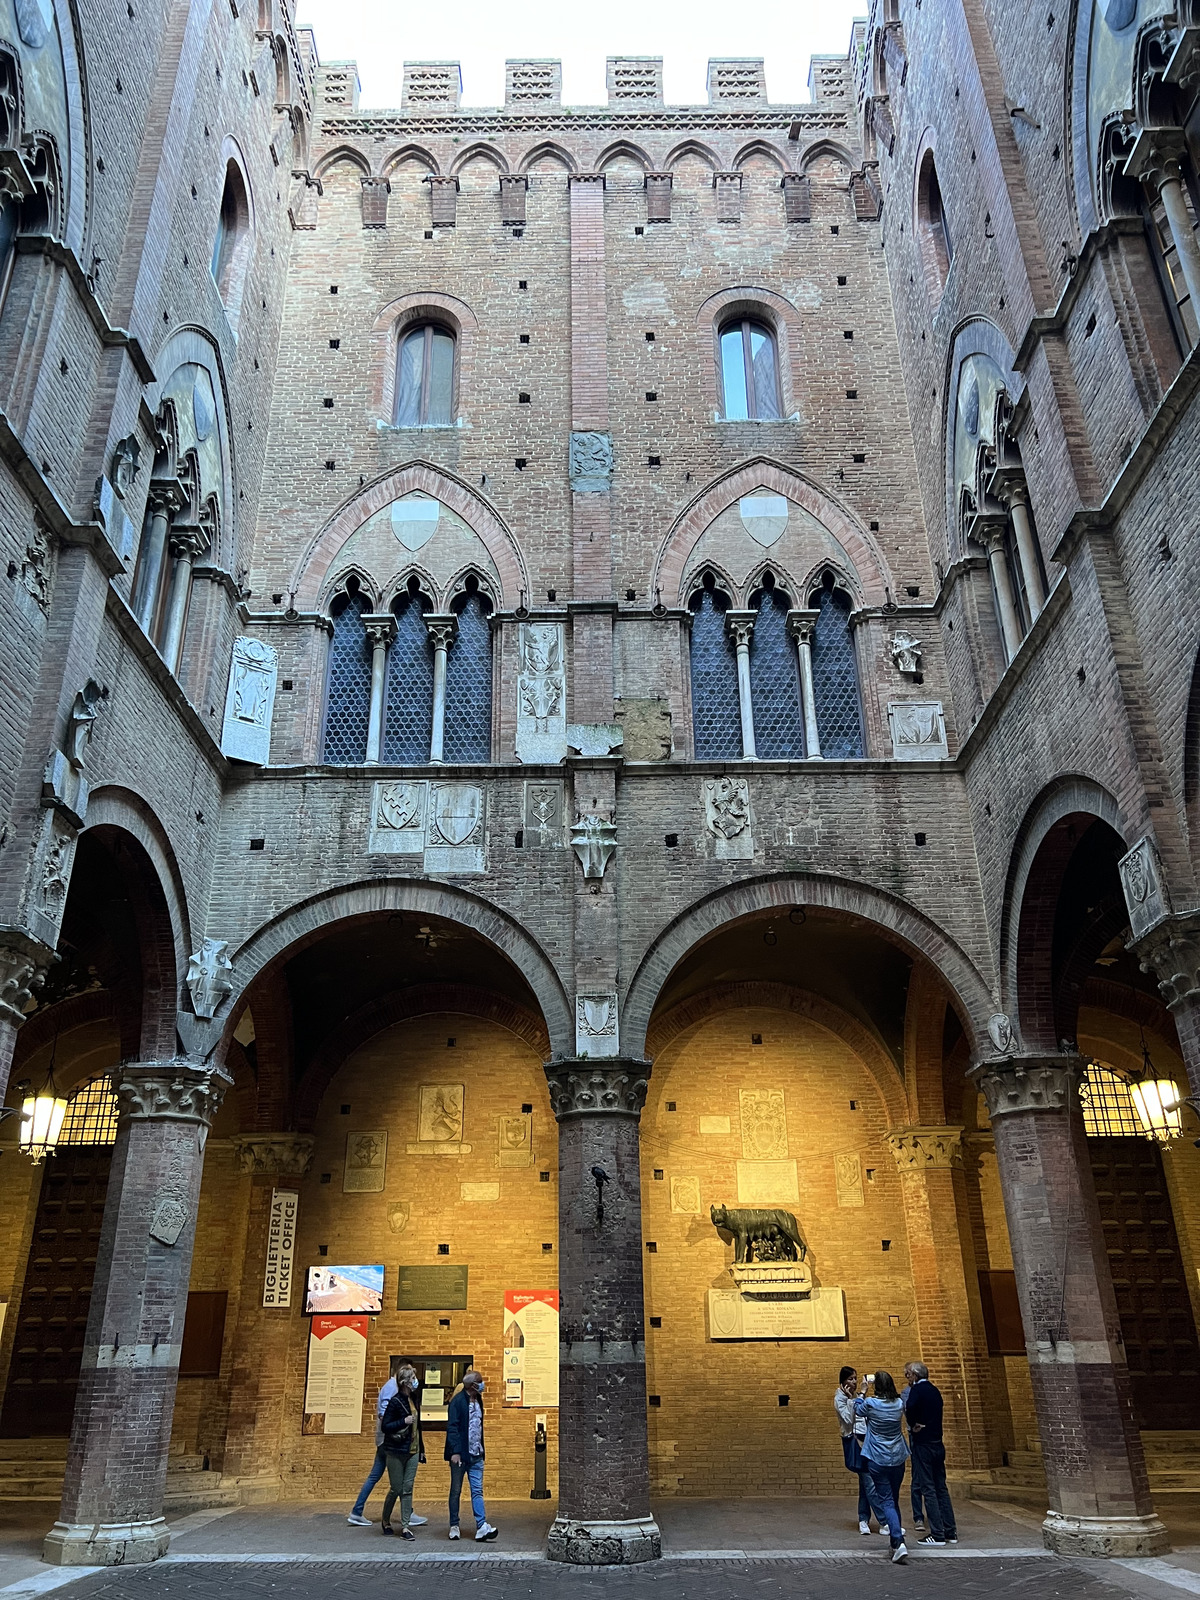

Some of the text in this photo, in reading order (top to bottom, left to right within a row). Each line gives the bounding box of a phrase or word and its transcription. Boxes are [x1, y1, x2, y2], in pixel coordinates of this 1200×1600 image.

[265, 1202, 283, 1303] BIGLIETTERIA
[278, 1202, 295, 1303] TICKET OFFICE
